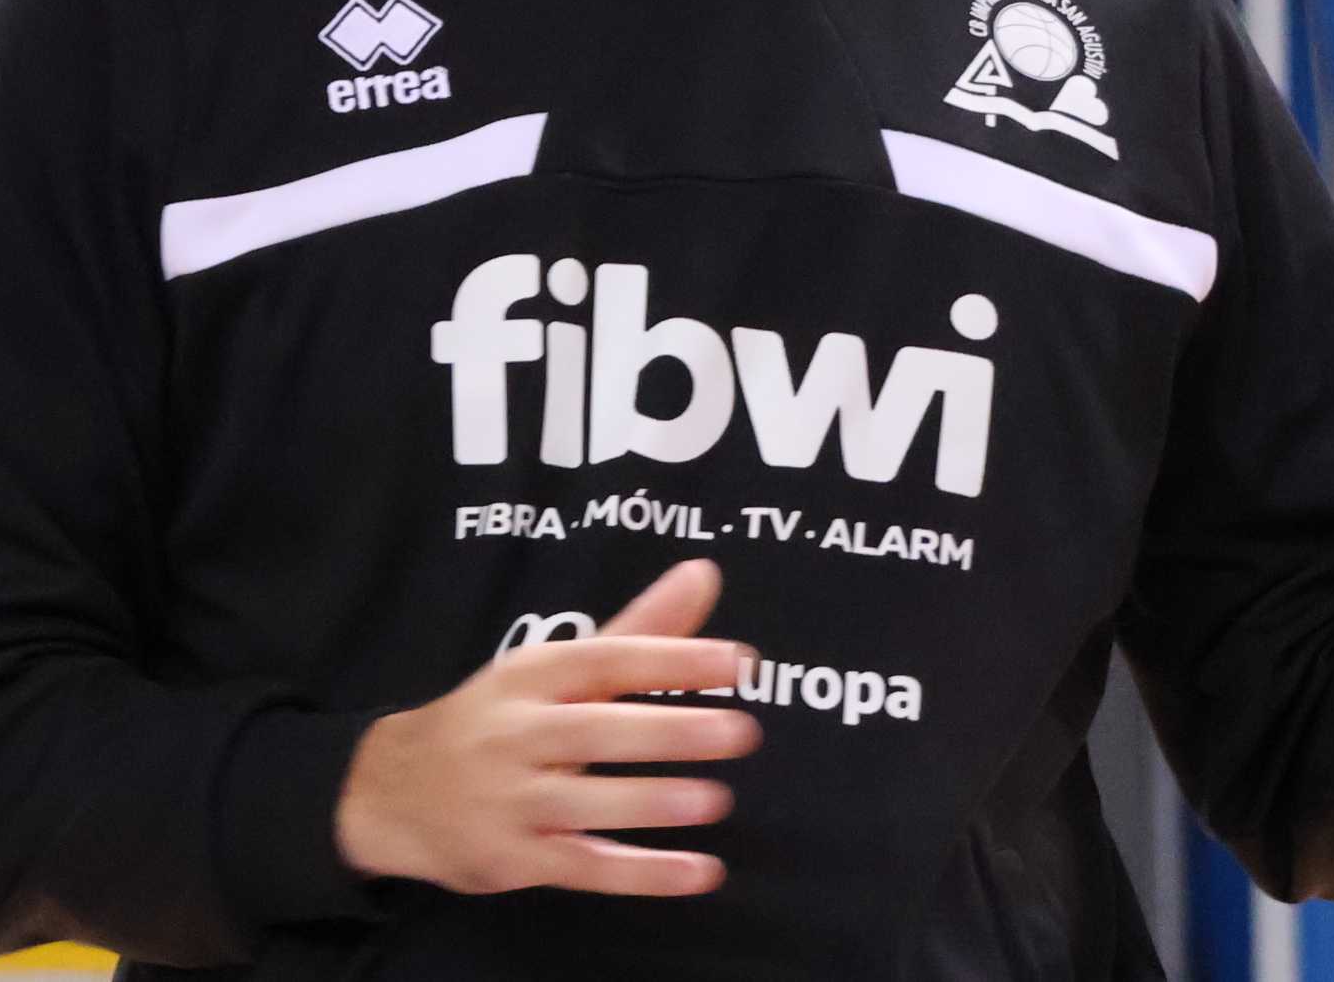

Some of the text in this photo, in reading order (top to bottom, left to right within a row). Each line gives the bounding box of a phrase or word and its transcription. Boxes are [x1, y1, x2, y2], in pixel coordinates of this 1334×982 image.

[1076, 25, 1108, 80] AGUSTÍN
[431, 254, 998, 498] fibwi
[455, 488, 974, 570] FIBRA MÓVIL TV ALARM
